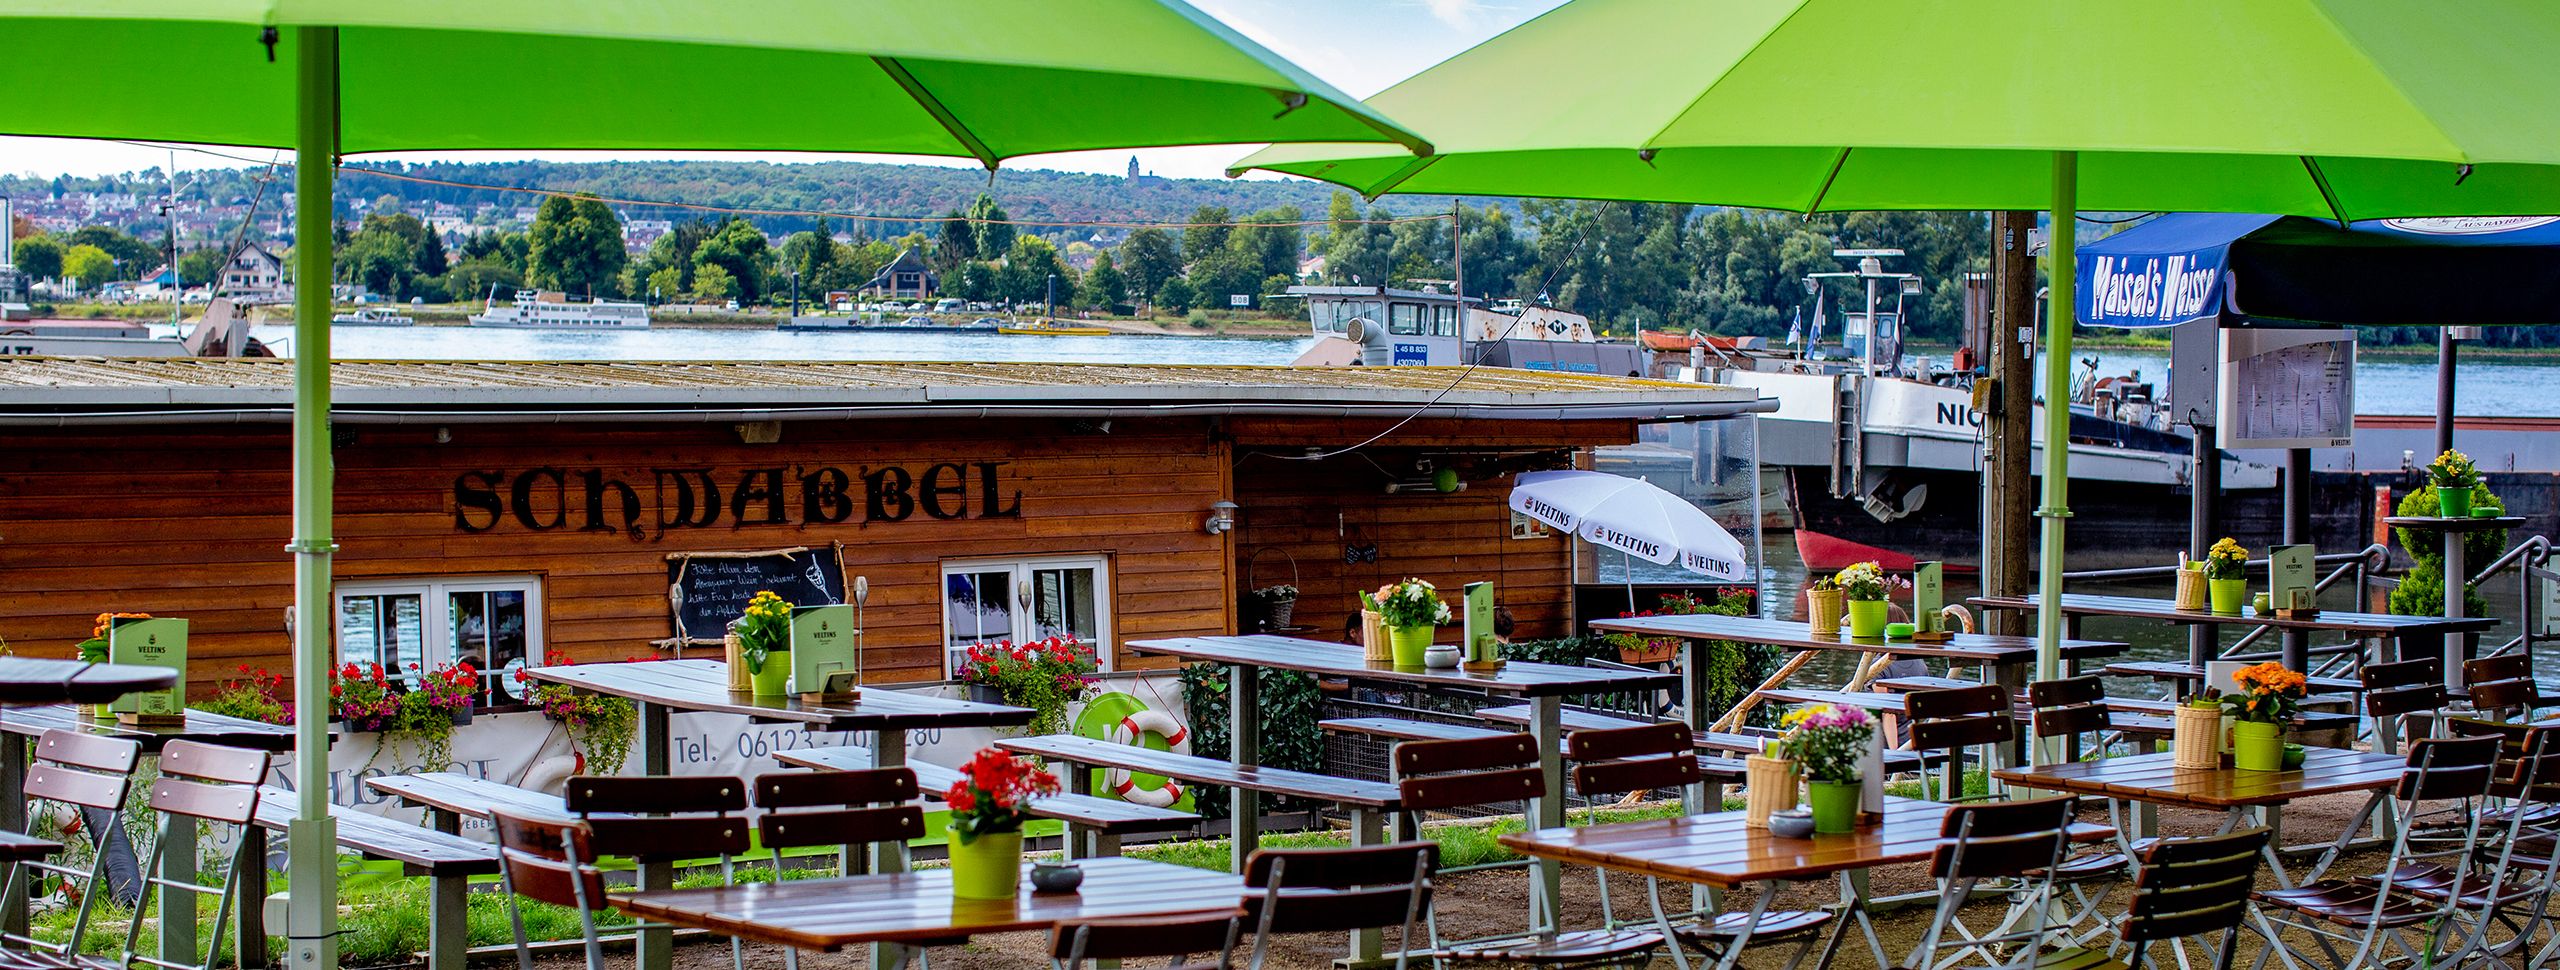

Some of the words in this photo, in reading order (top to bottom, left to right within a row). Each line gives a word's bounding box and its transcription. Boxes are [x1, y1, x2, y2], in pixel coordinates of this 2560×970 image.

[2091, 255, 2161, 319] Maisel's
[1233, 296, 1248, 304] 508
[1533, 500, 1571, 528] VELTINS
[1606, 529, 1660, 558] VELTINS
[1693, 554, 1731, 575] VELTINS
[813, 631, 837, 639] VELTINS
[138, 646, 166, 654] VELTINS
[675, 734, 717, 763] Tel.
[738, 728, 814, 759] 06123
